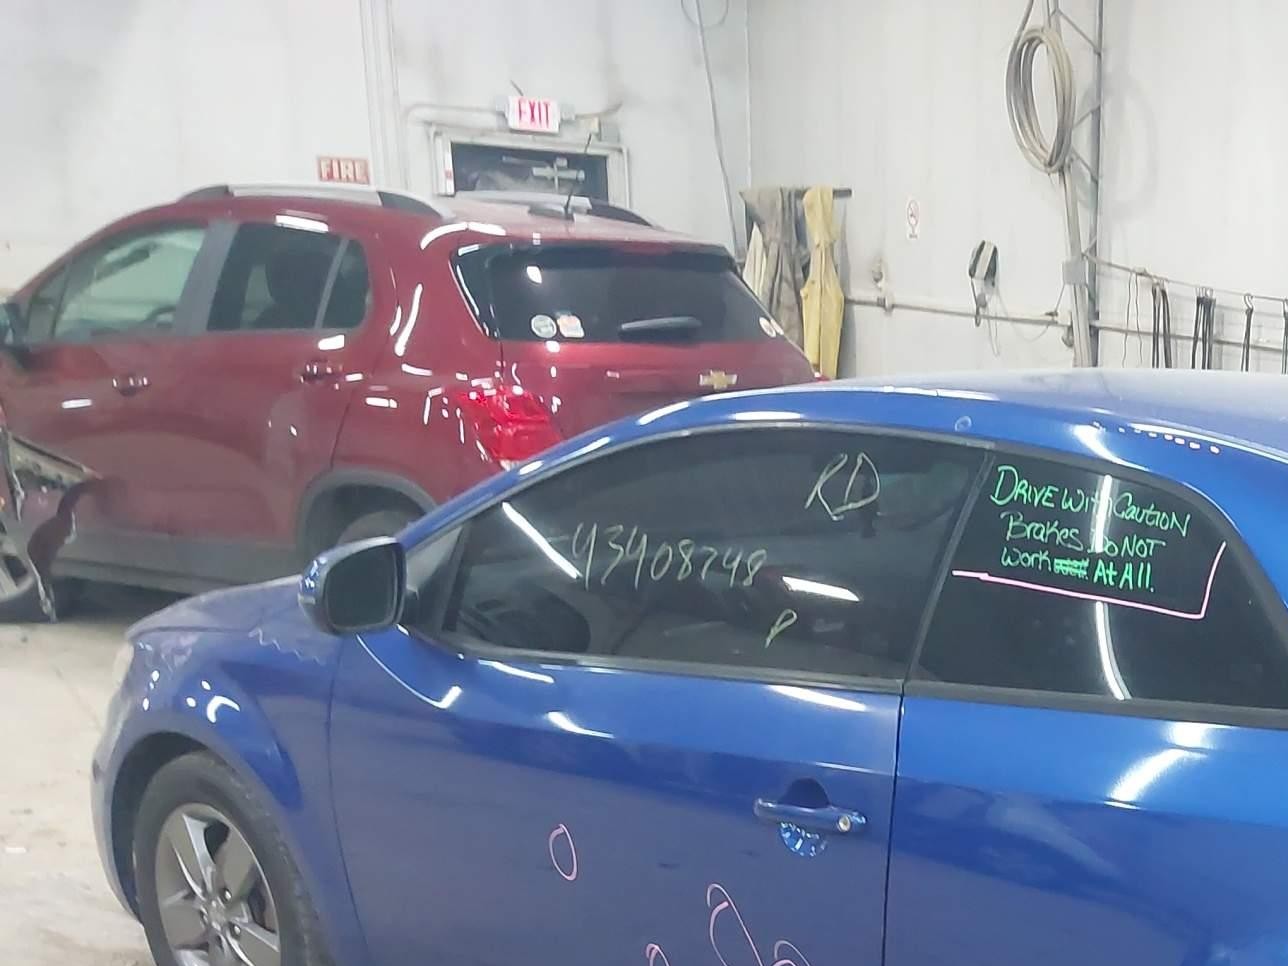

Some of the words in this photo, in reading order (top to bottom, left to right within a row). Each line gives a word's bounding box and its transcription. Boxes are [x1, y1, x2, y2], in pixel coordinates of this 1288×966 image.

[517, 99, 551, 128] EXIT
[319, 157, 368, 183] FIRE
[572, 522, 768, 592] 43408748
[1120, 537, 1166, 558] NOT
[1093, 559, 1118, 587] At
